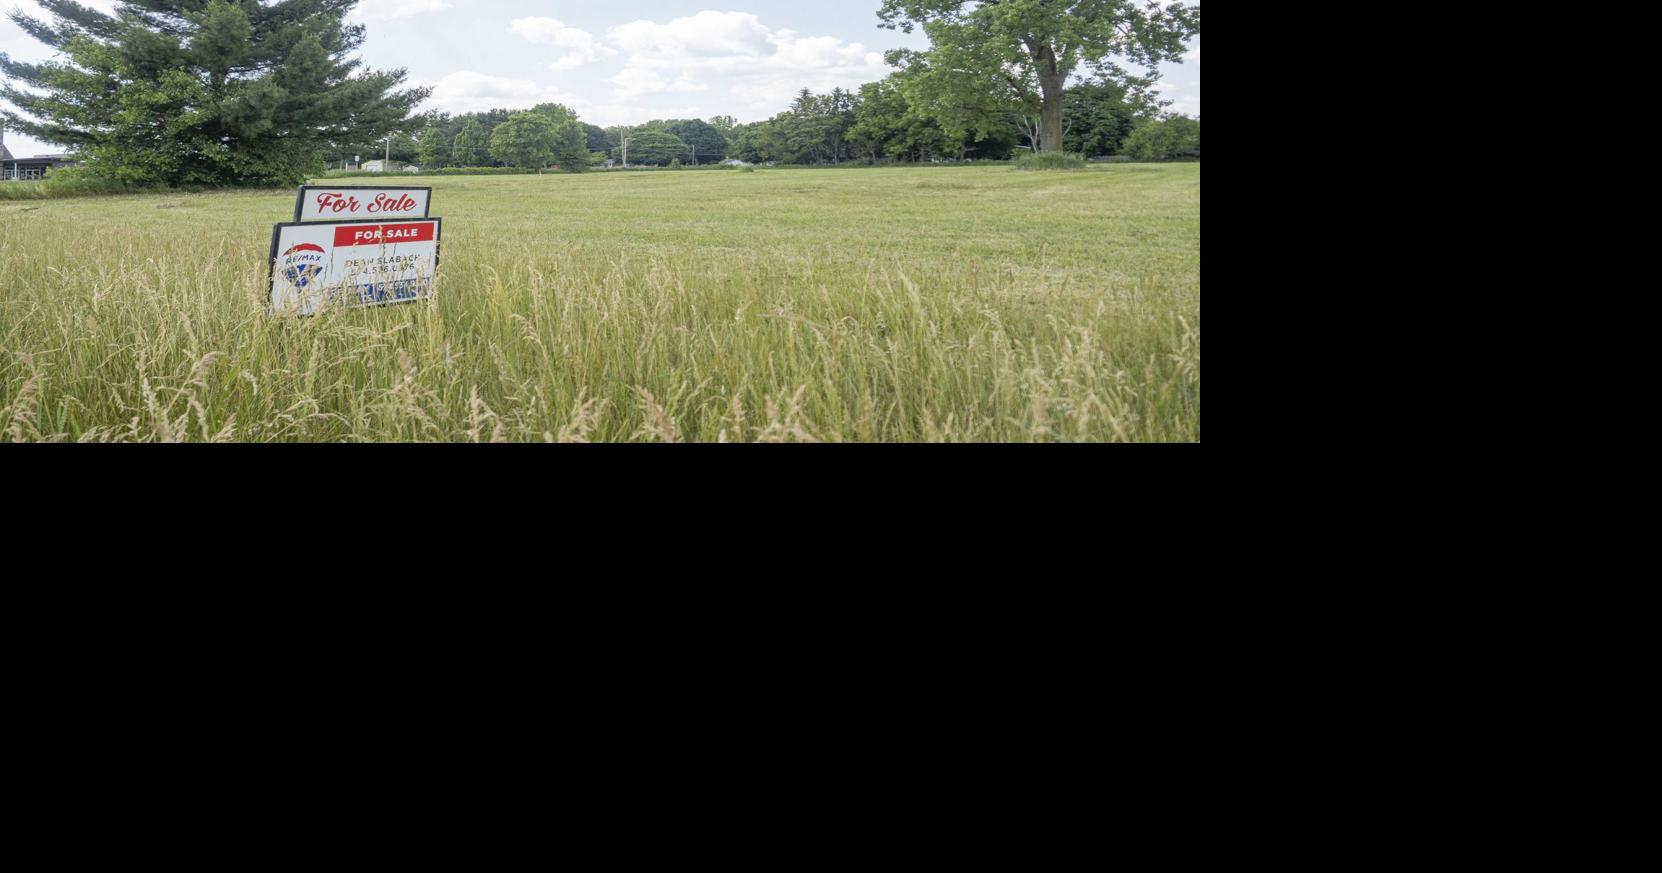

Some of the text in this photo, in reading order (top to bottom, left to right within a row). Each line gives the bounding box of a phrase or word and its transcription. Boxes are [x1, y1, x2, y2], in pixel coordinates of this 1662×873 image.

[317, 192, 416, 213] For Sale
[354, 228, 418, 240] FOR SALE
